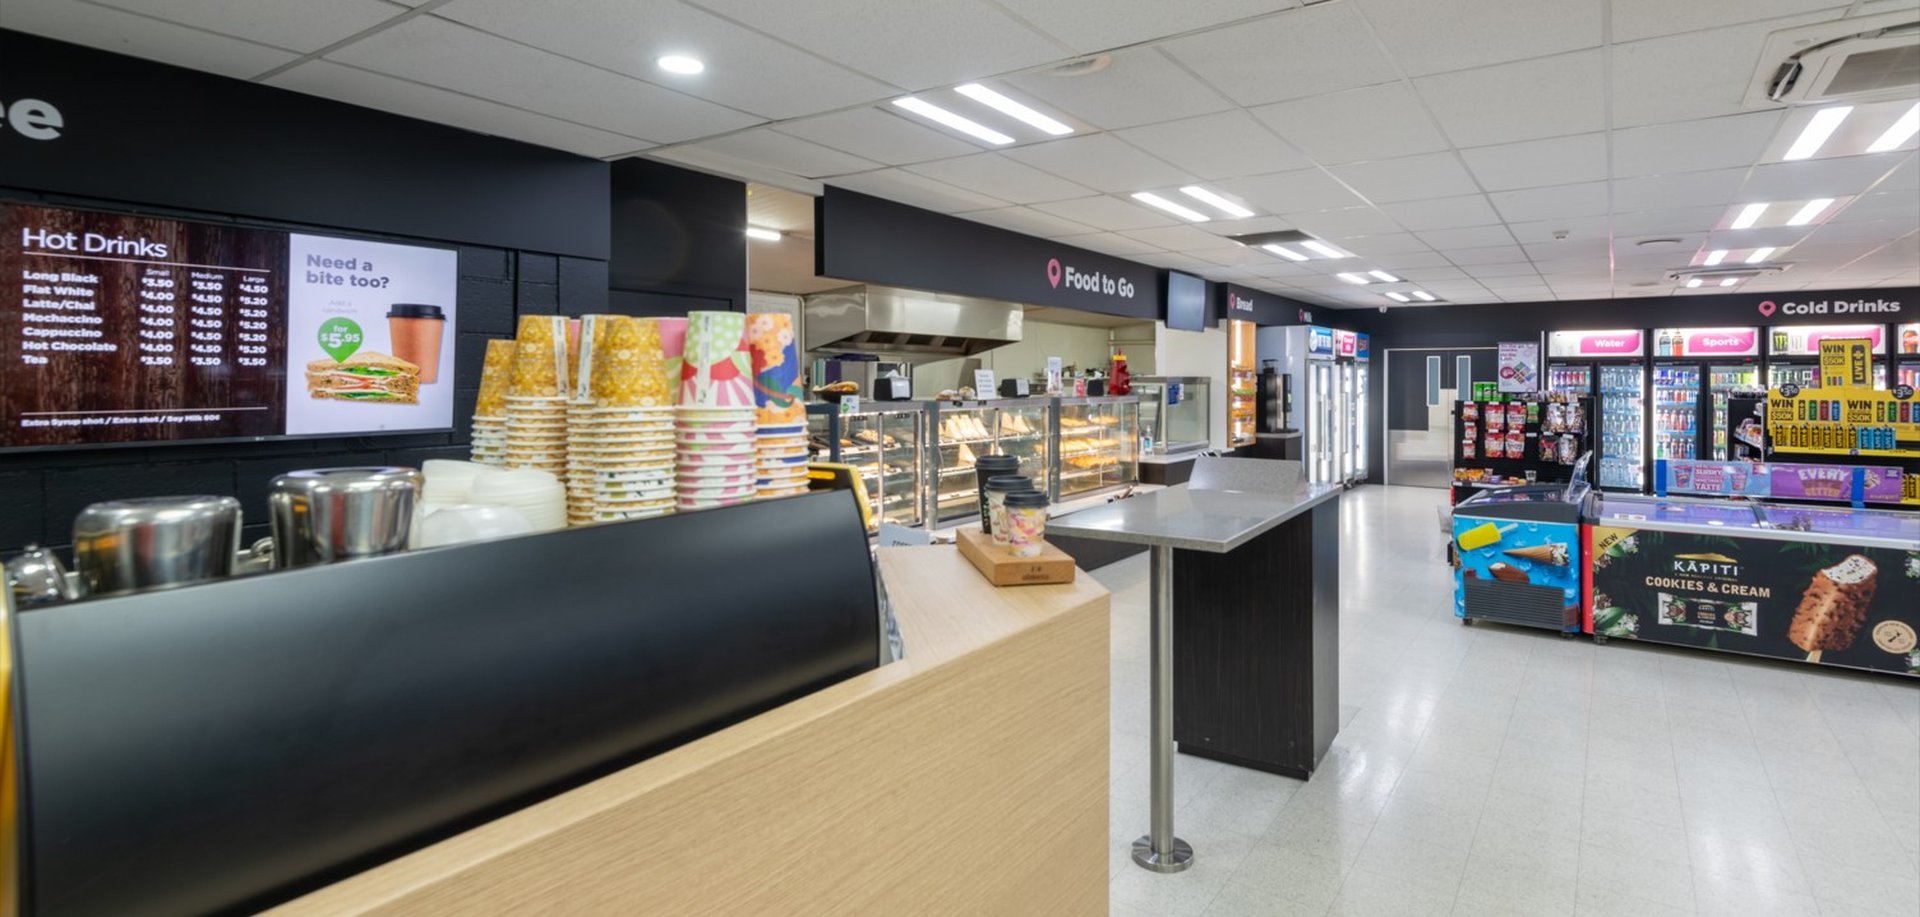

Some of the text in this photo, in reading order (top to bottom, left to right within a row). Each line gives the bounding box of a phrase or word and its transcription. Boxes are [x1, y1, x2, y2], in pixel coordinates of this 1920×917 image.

[22, 228, 168, 258] Hot Drinks
[306, 254, 373, 272] Need a
[23, 270, 268, 294] Long Black $3.50 $3.50 $4.50
[146, 268, 170, 276] Small
[192, 272, 224, 280] Medium
[306, 270, 390, 288] bite too?
[1065, 266, 1134, 298] Food to Go
[23, 285, 268, 306] Flat White $4.00 $4.50 $5.20
[23, 298, 267, 318] Latte/Chai $4.00 $4.50 $5.20
[1236, 296, 1253, 312] Bread
[1782, 299, 1901, 315] Cold Drinks
[22, 313, 267, 330] Mochaccino $4.00 $4.50 $5.20
[22, 327, 267, 342] Cappuccino $4.00 $4.50 $5.20
[320, 332, 360, 348] $5.95
[22, 342, 267, 354] Hot Chocolate $4.00 $4.50 $5.20
[1594, 339, 1625, 348] Water
[1702, 338, 1739, 348] Sports
[1822, 344, 1845, 353] WIN
[22, 355, 266, 366] Tea $3.50 $3.50 $3.50
[1771, 400, 1793, 408] WIN
[1848, 400, 1871, 409] WIN
[21, 419, 49, 427] Extra
[51, 418, 80, 427] Syrup
[82, 416, 104, 425] shot
[112, 416, 138, 424] Extra
[138, 415, 159, 423] shot
[1797, 468, 1849, 481] EVERY
[1599, 533, 1619, 550] NEW
[1674, 560, 1738, 576] KĀPITI
[1645, 576, 1771, 598] COOKIES & CREAM
